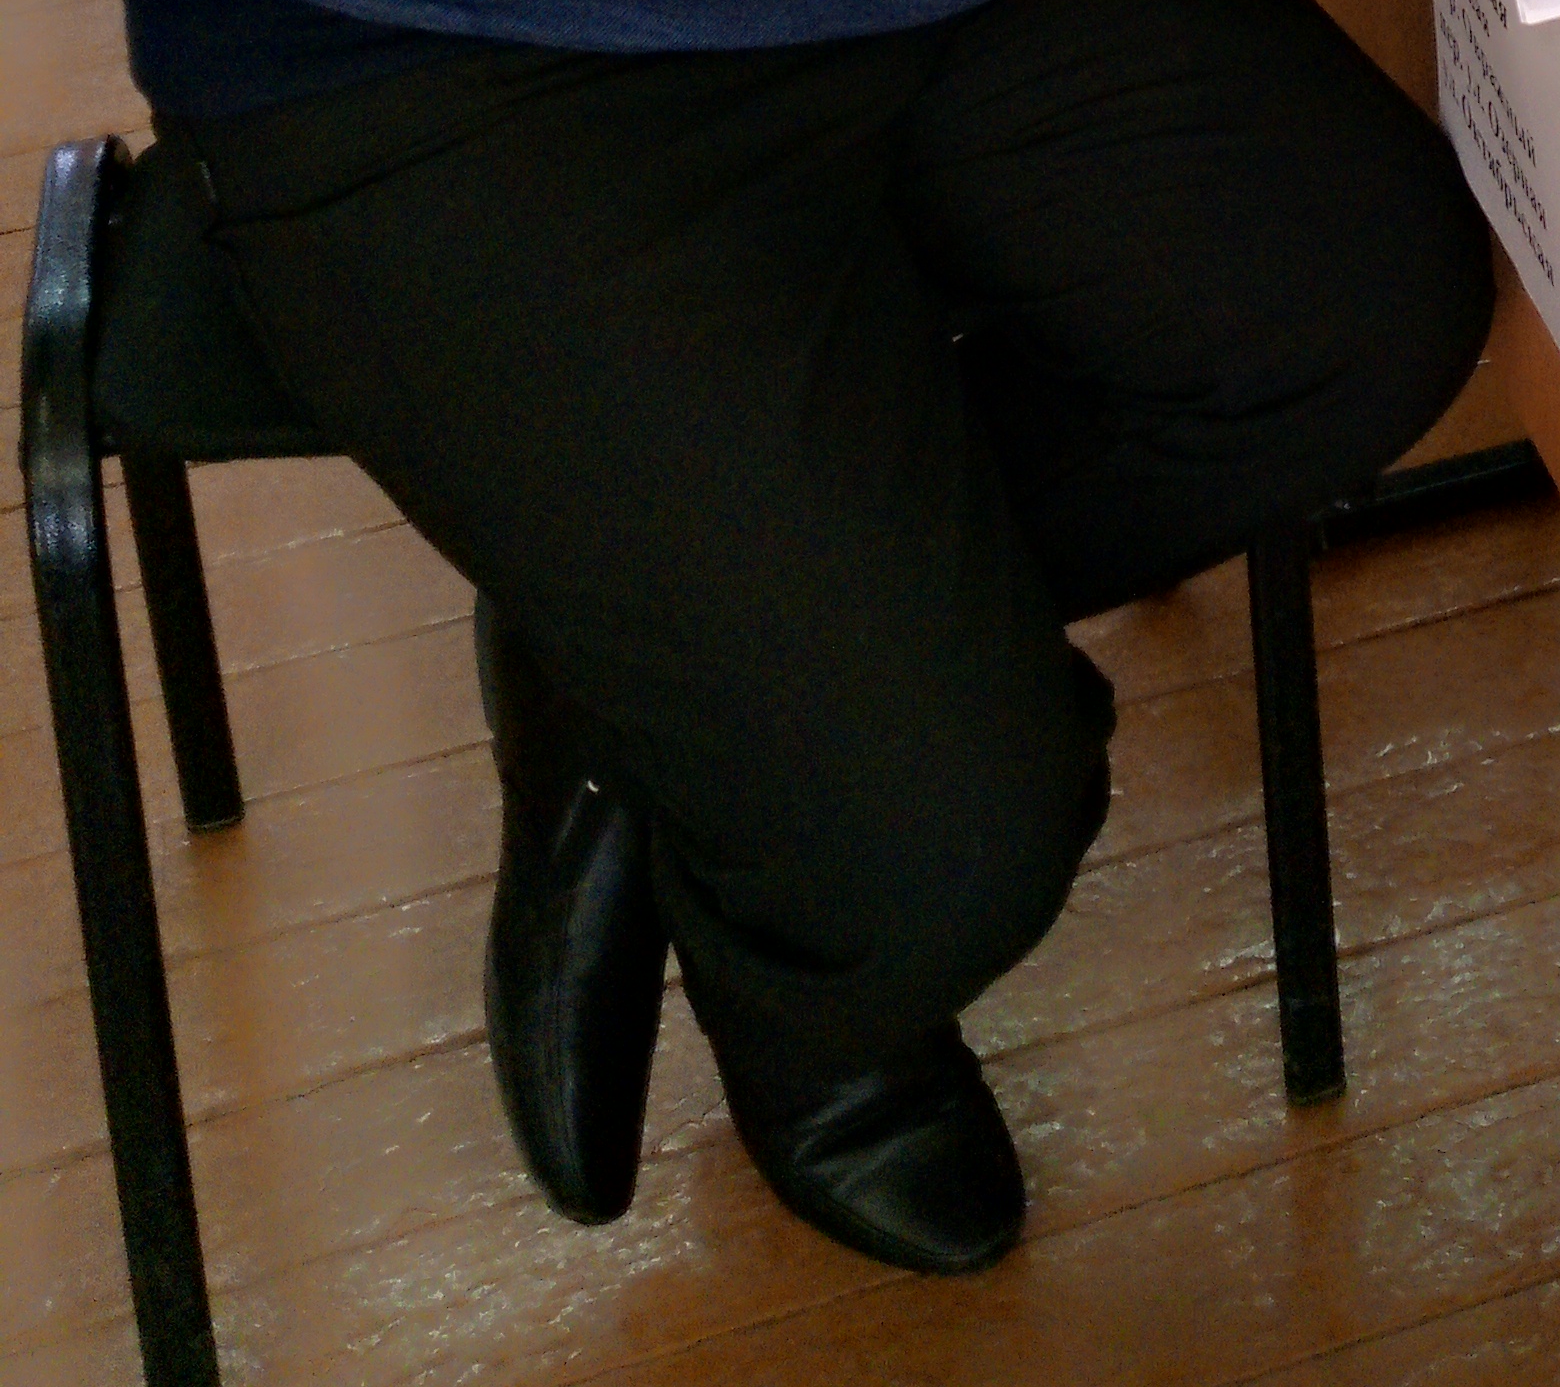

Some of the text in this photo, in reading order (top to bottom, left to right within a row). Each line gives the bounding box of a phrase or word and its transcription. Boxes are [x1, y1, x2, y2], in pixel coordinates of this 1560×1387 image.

[1440, 12, 1463, 70] пер.
[1488, 101, 1547, 230] Озерная
[1462, 8, 1536, 168] Овражный
[1461, 95, 1554, 287] Октябрьская
